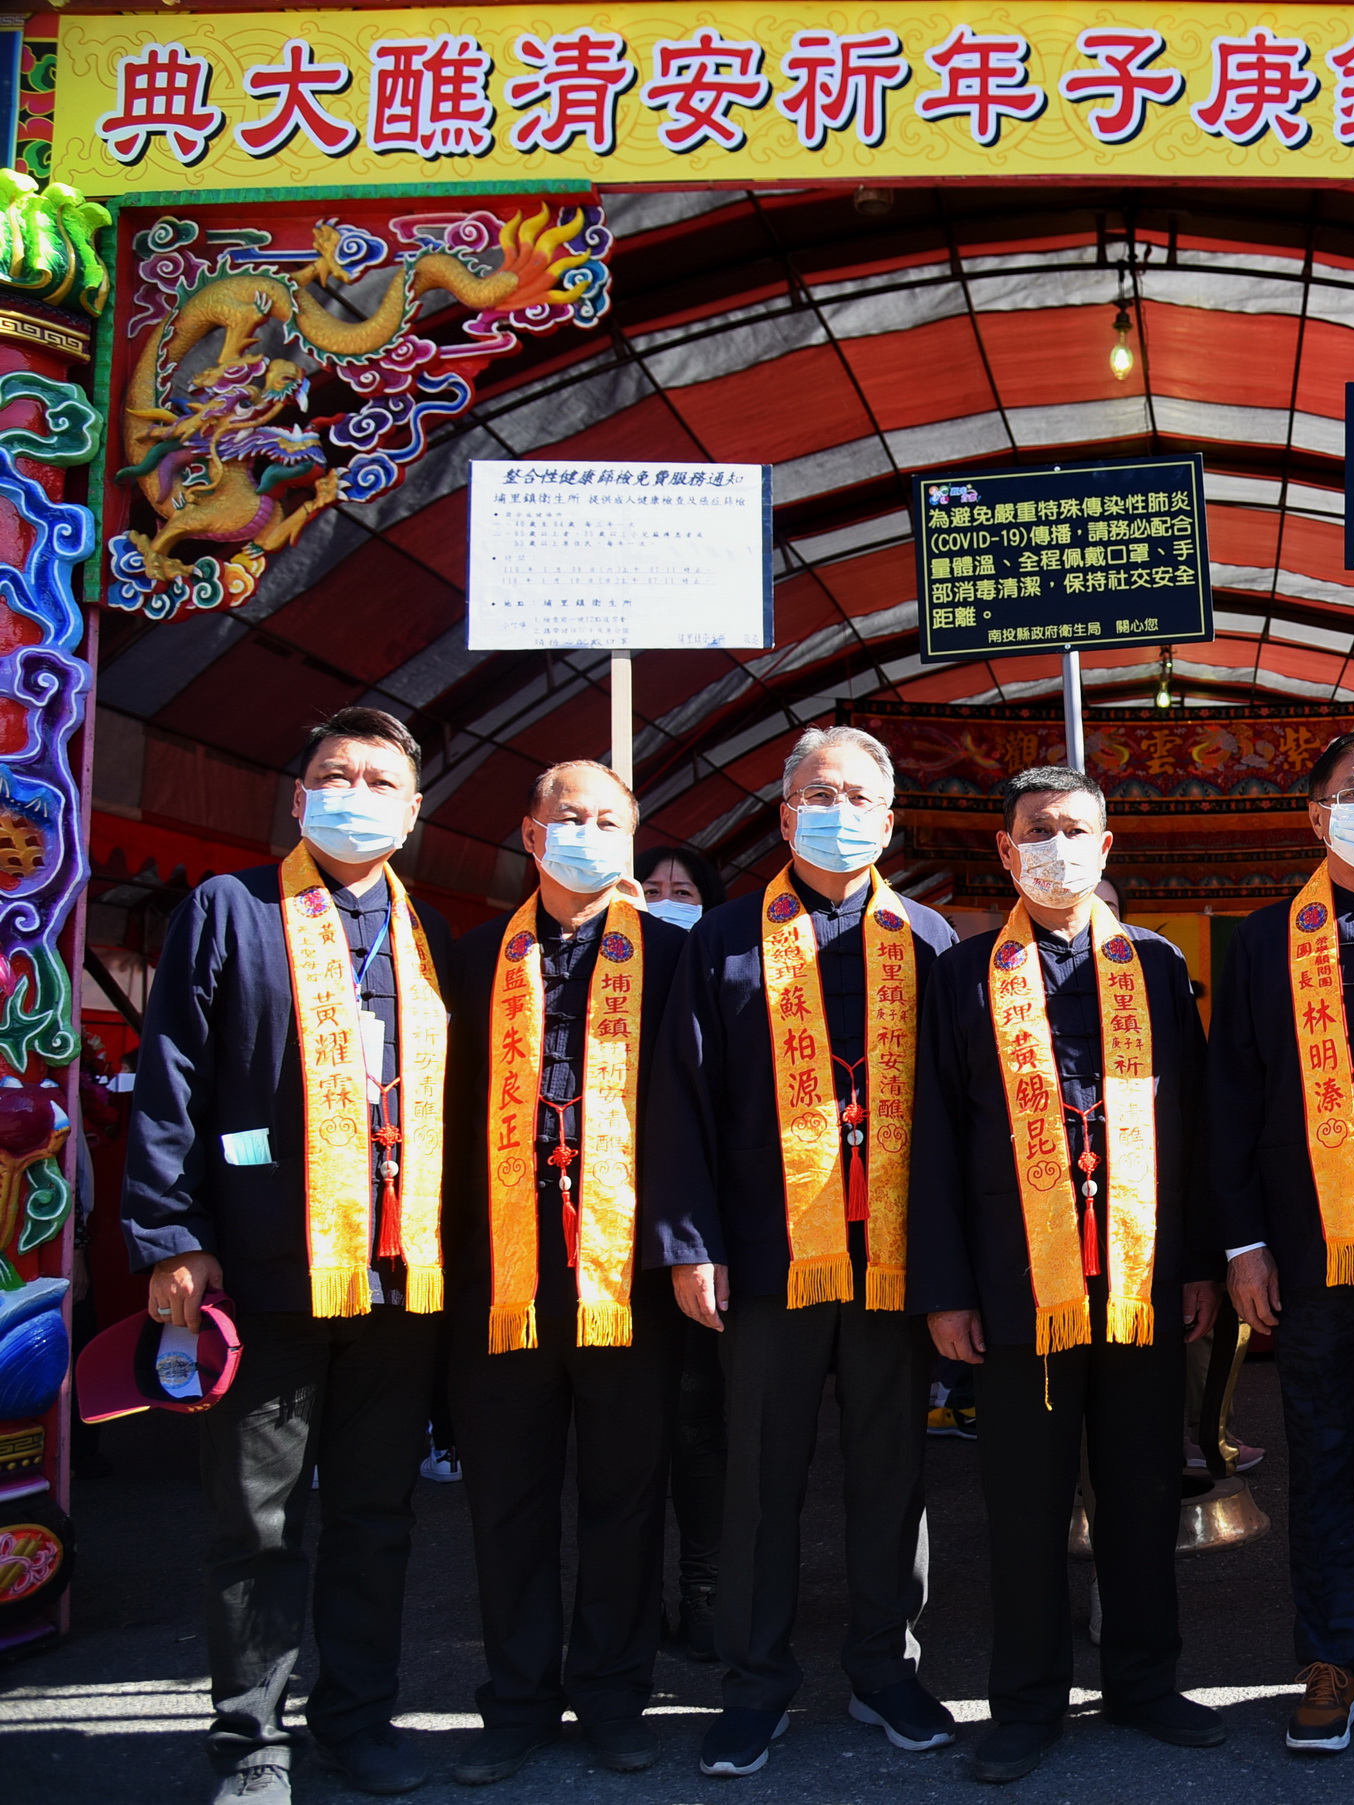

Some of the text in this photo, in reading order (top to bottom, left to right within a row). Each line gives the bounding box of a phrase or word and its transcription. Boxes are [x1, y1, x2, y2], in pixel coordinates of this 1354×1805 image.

[502, 468, 744, 487] 整合性健康篩檢免費服務通知
[494, 492, 580, 504] 埔里鎮衛生所
[928, 490, 1192, 529] 為避免嚴重特殊傳染性肺炎
[931, 566, 1196, 604] 部消毒清潔，保持社交安全
[987, 618, 1159, 644] 南投縣政府衛生局 關心您
